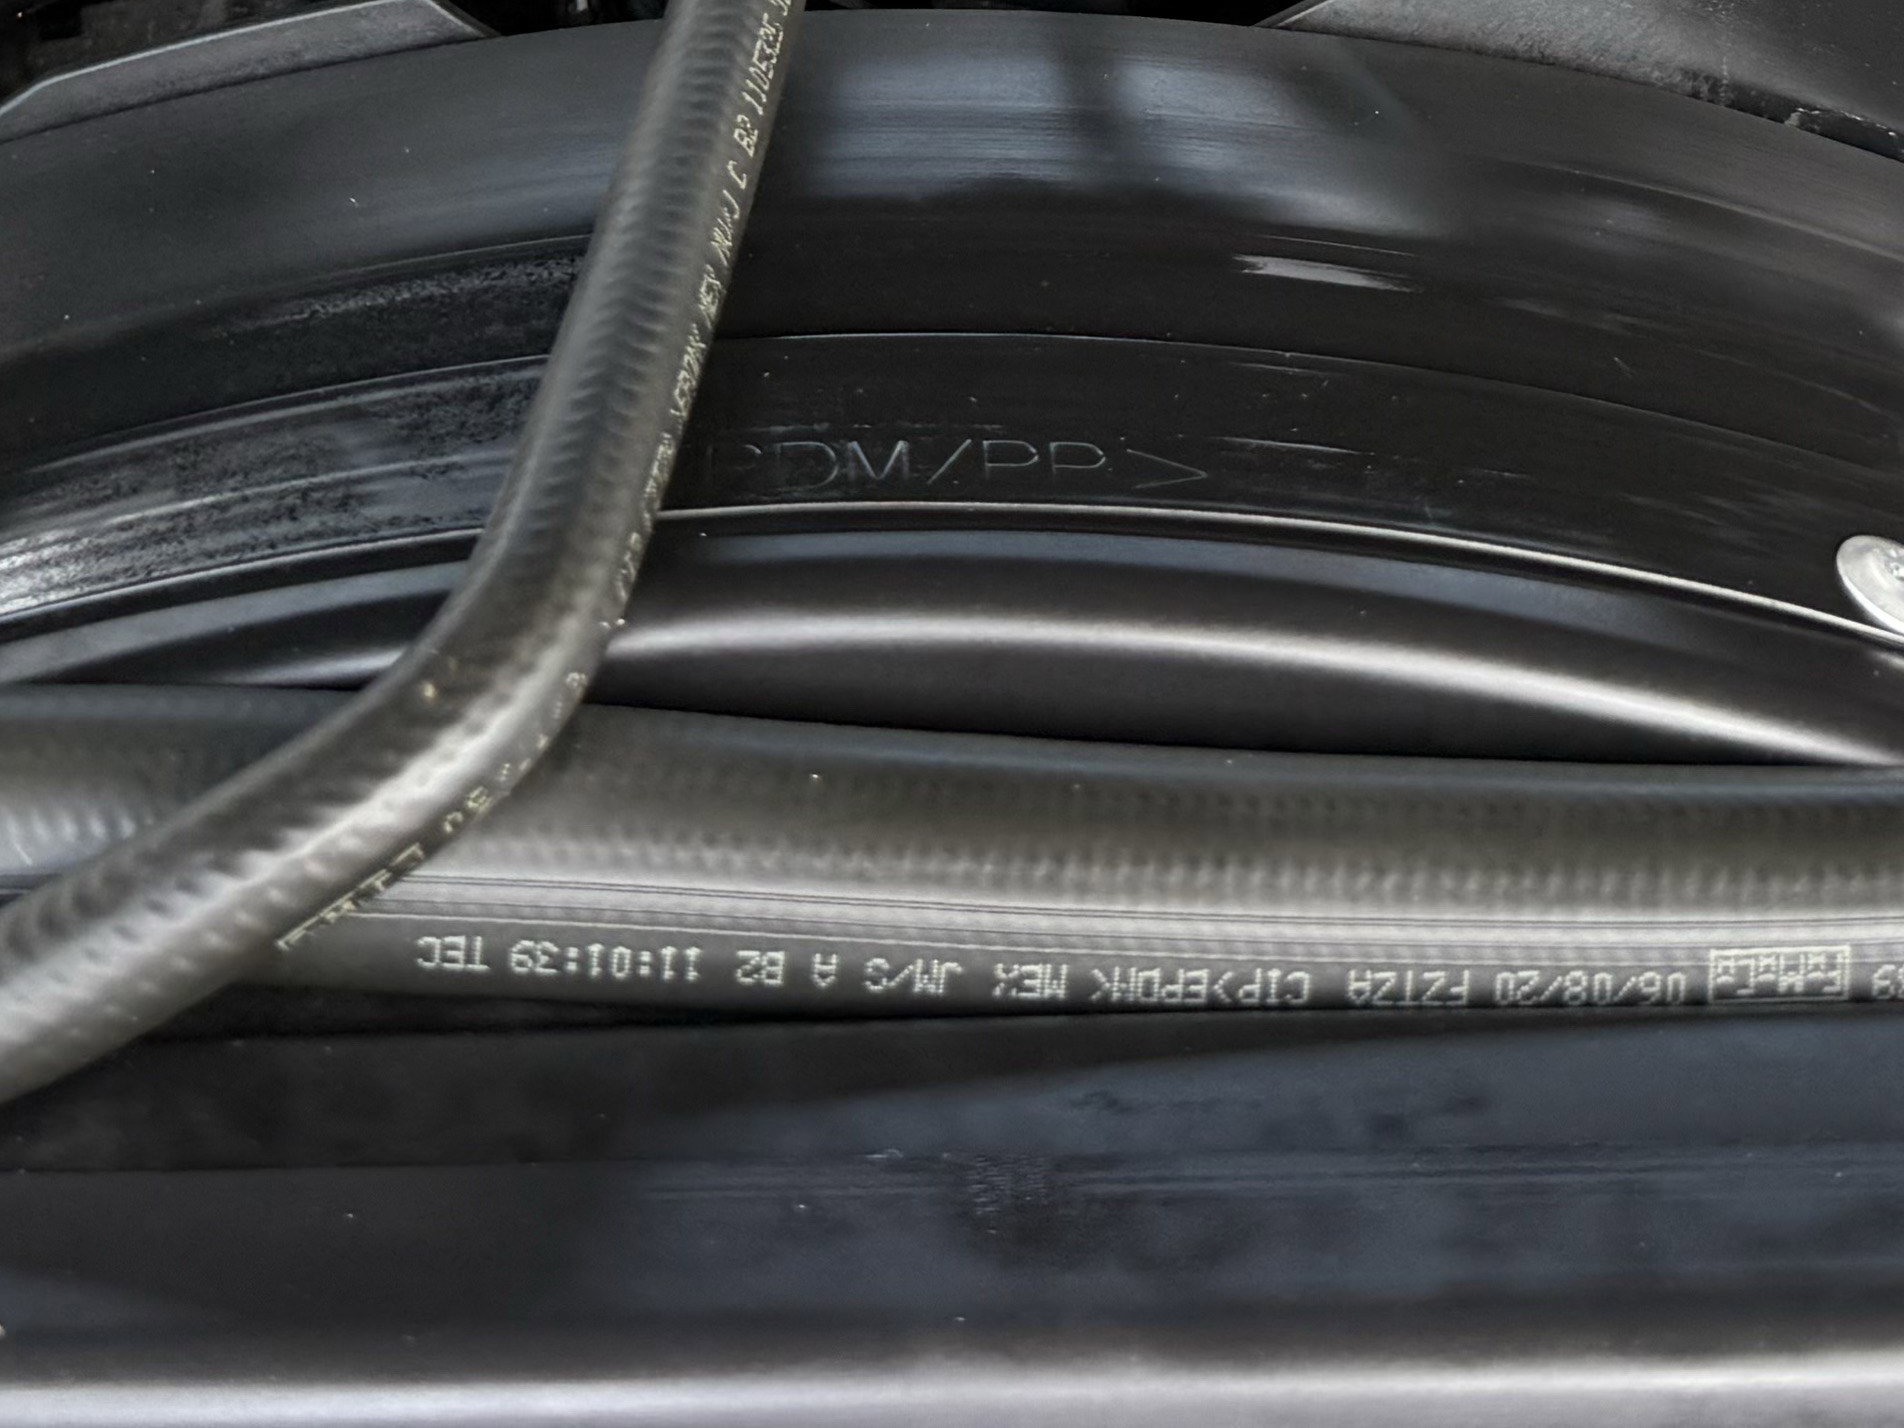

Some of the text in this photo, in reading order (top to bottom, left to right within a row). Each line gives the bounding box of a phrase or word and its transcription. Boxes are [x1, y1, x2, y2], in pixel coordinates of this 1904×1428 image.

[414, 934, 489, 972] TEC
[735, 948, 786, 987] B2
[811, 952, 838, 988] A
[992, 962, 1069, 1001] MEX
